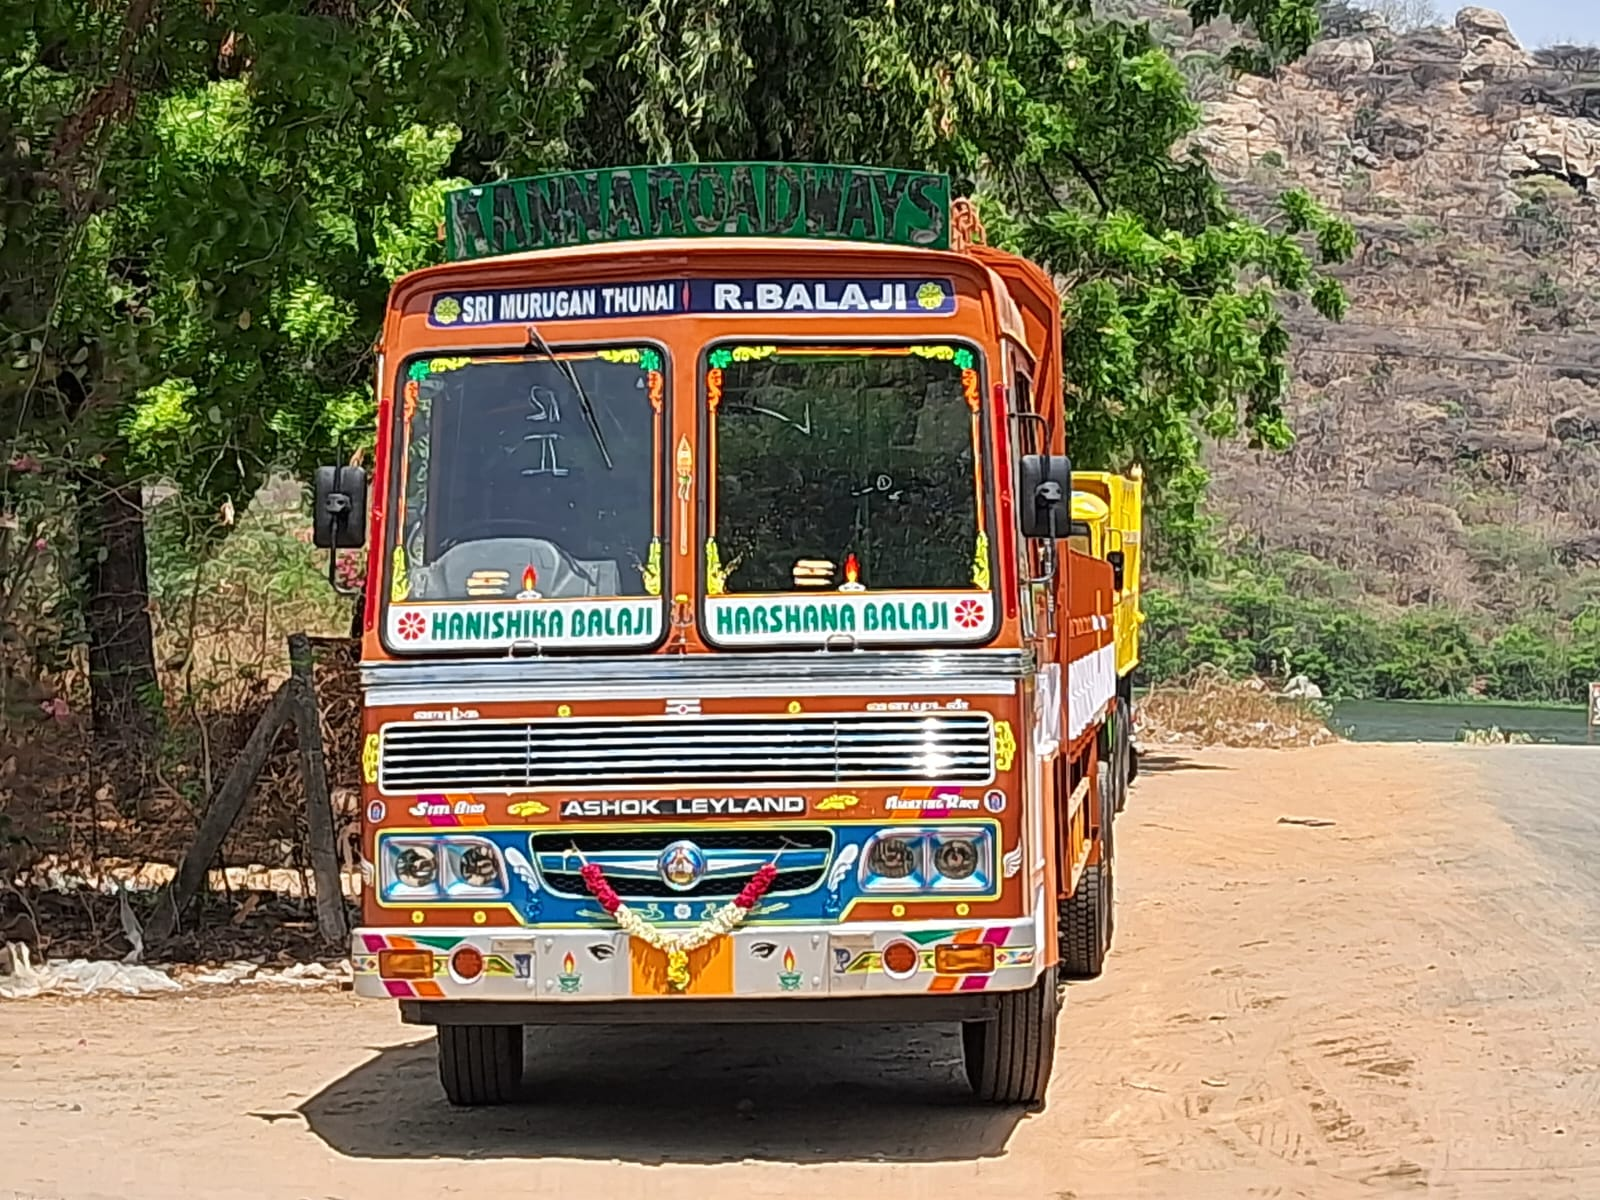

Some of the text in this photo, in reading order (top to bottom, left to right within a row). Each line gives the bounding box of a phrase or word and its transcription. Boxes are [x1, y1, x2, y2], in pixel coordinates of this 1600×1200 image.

[462, 284, 675, 323] SRI MURUGAN THUNAI
[713, 282, 908, 311] R.BALAJI
[431, 606, 653, 641] HANISHIKA BALAJI
[716, 601, 949, 635] HARSHANA BALAJI
[560, 796, 805, 817] ASHOK LEYLAND
